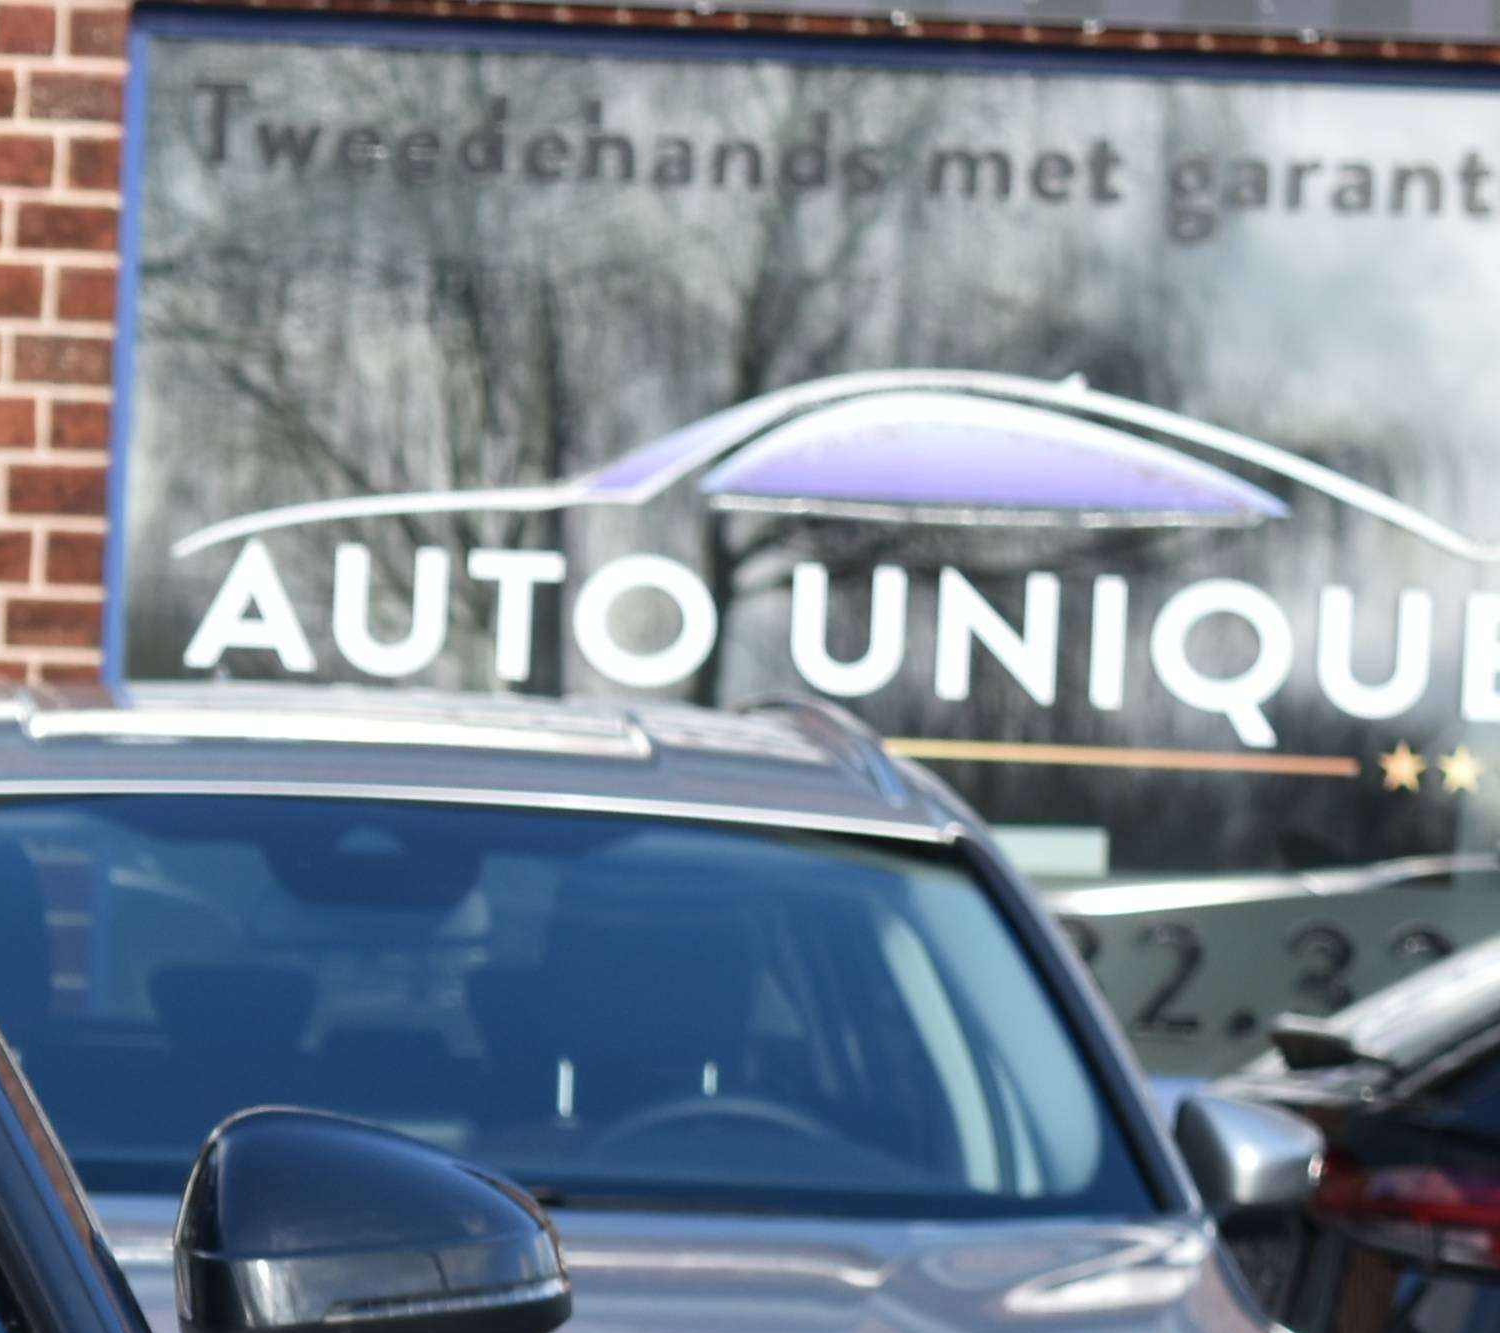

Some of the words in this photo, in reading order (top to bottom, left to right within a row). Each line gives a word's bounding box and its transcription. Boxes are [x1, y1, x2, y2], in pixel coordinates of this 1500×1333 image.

[195, 83, 882, 192] Tweedehands
[928, 137, 1123, 206] met
[183, 538, 718, 688] AUTO
